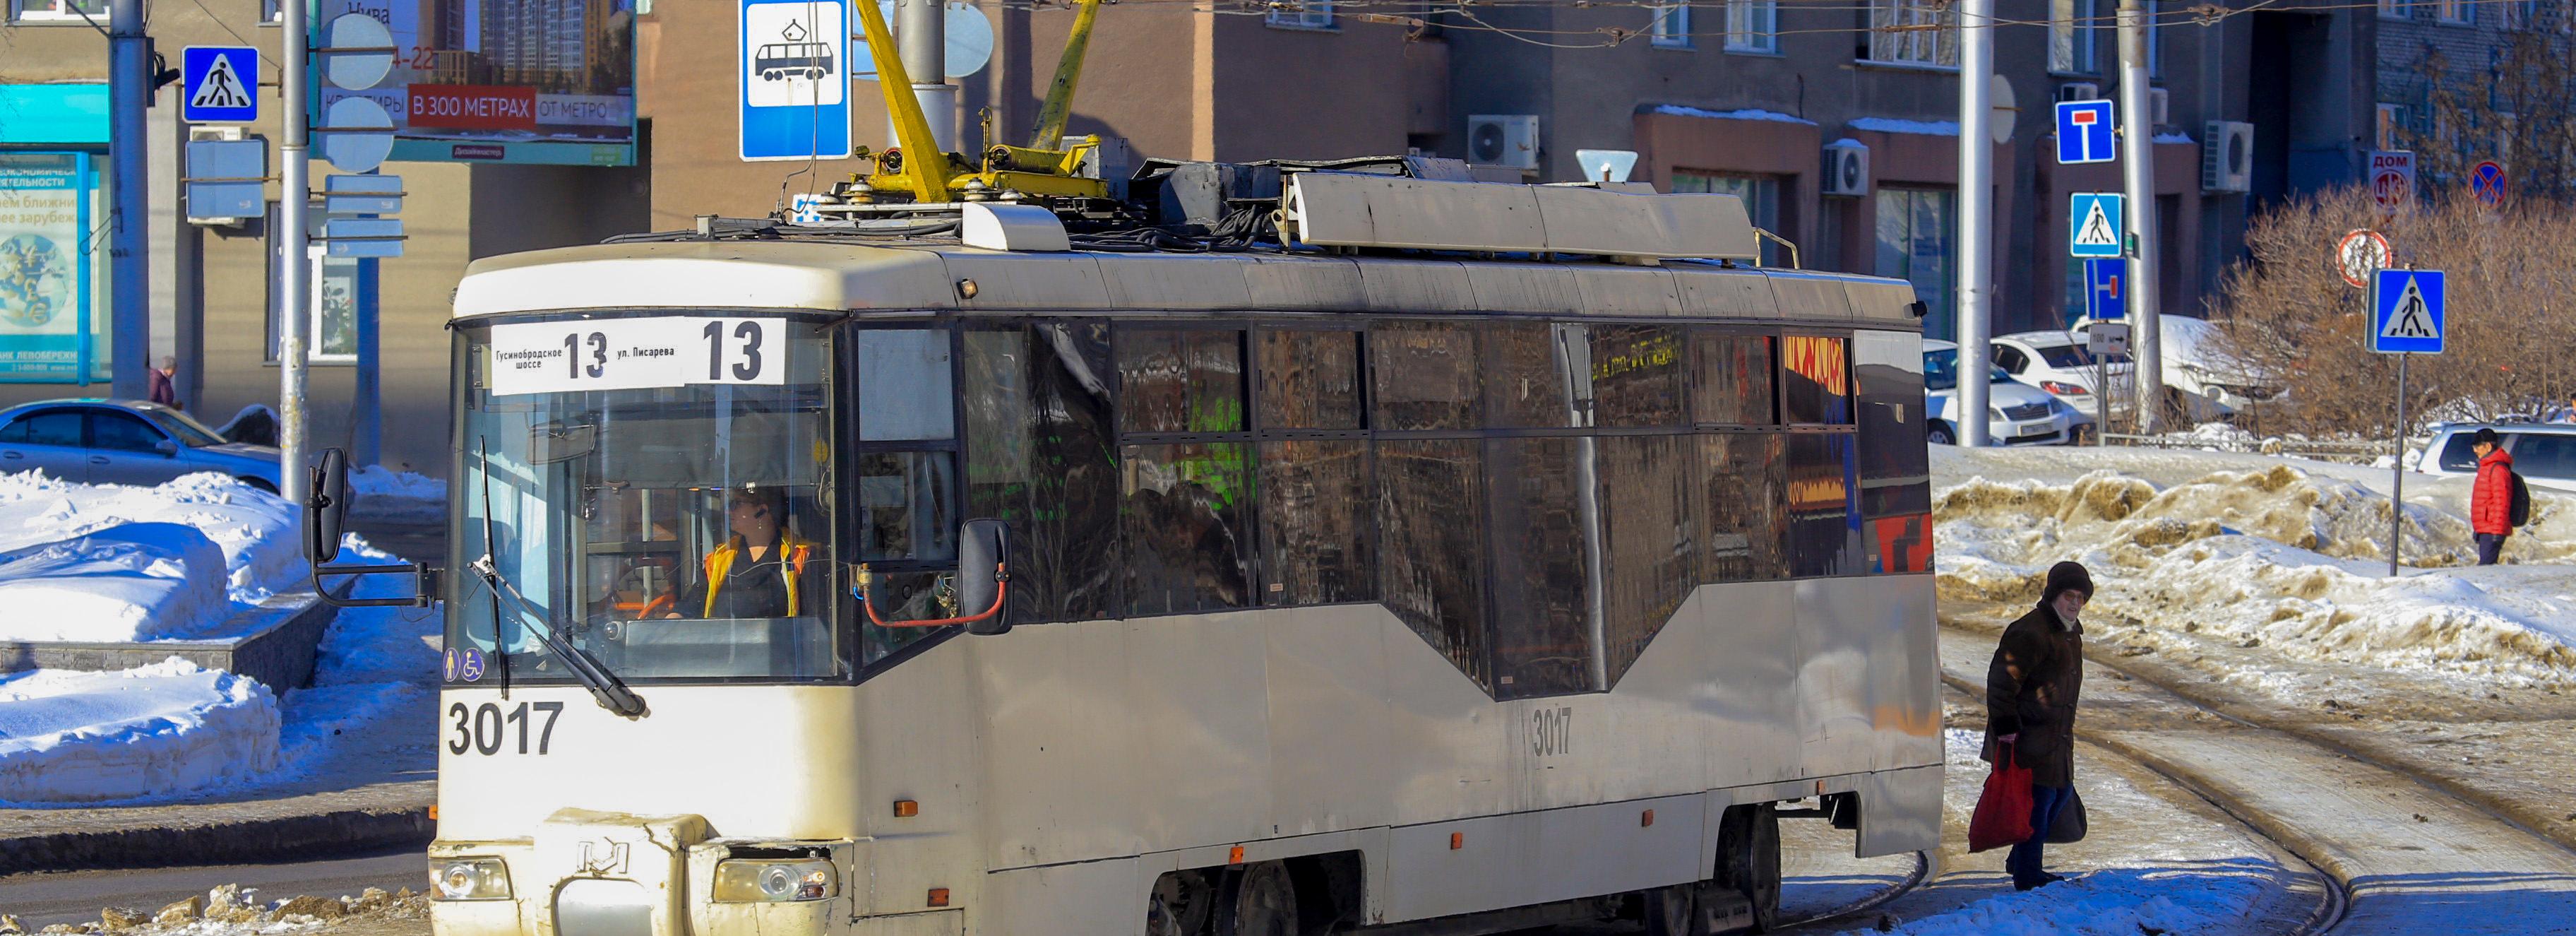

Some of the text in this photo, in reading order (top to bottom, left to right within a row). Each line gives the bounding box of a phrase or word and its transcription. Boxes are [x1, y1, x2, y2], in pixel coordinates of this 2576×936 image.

[326, 95, 607, 118] КИРЫ В 300 МЕТРАХ ОТ МЕТРО
[2374, 156, 2407, 168] ДОМ
[496, 349, 562, 362] Гусинобродское
[564, 331, 607, 379] 13
[617, 347, 674, 360] ул. Писарева
[703, 320, 763, 381] 13
[515, 360, 542, 369] шоссе
[448, 701, 564, 756] 3017
[1533, 706, 1572, 757] 3017
